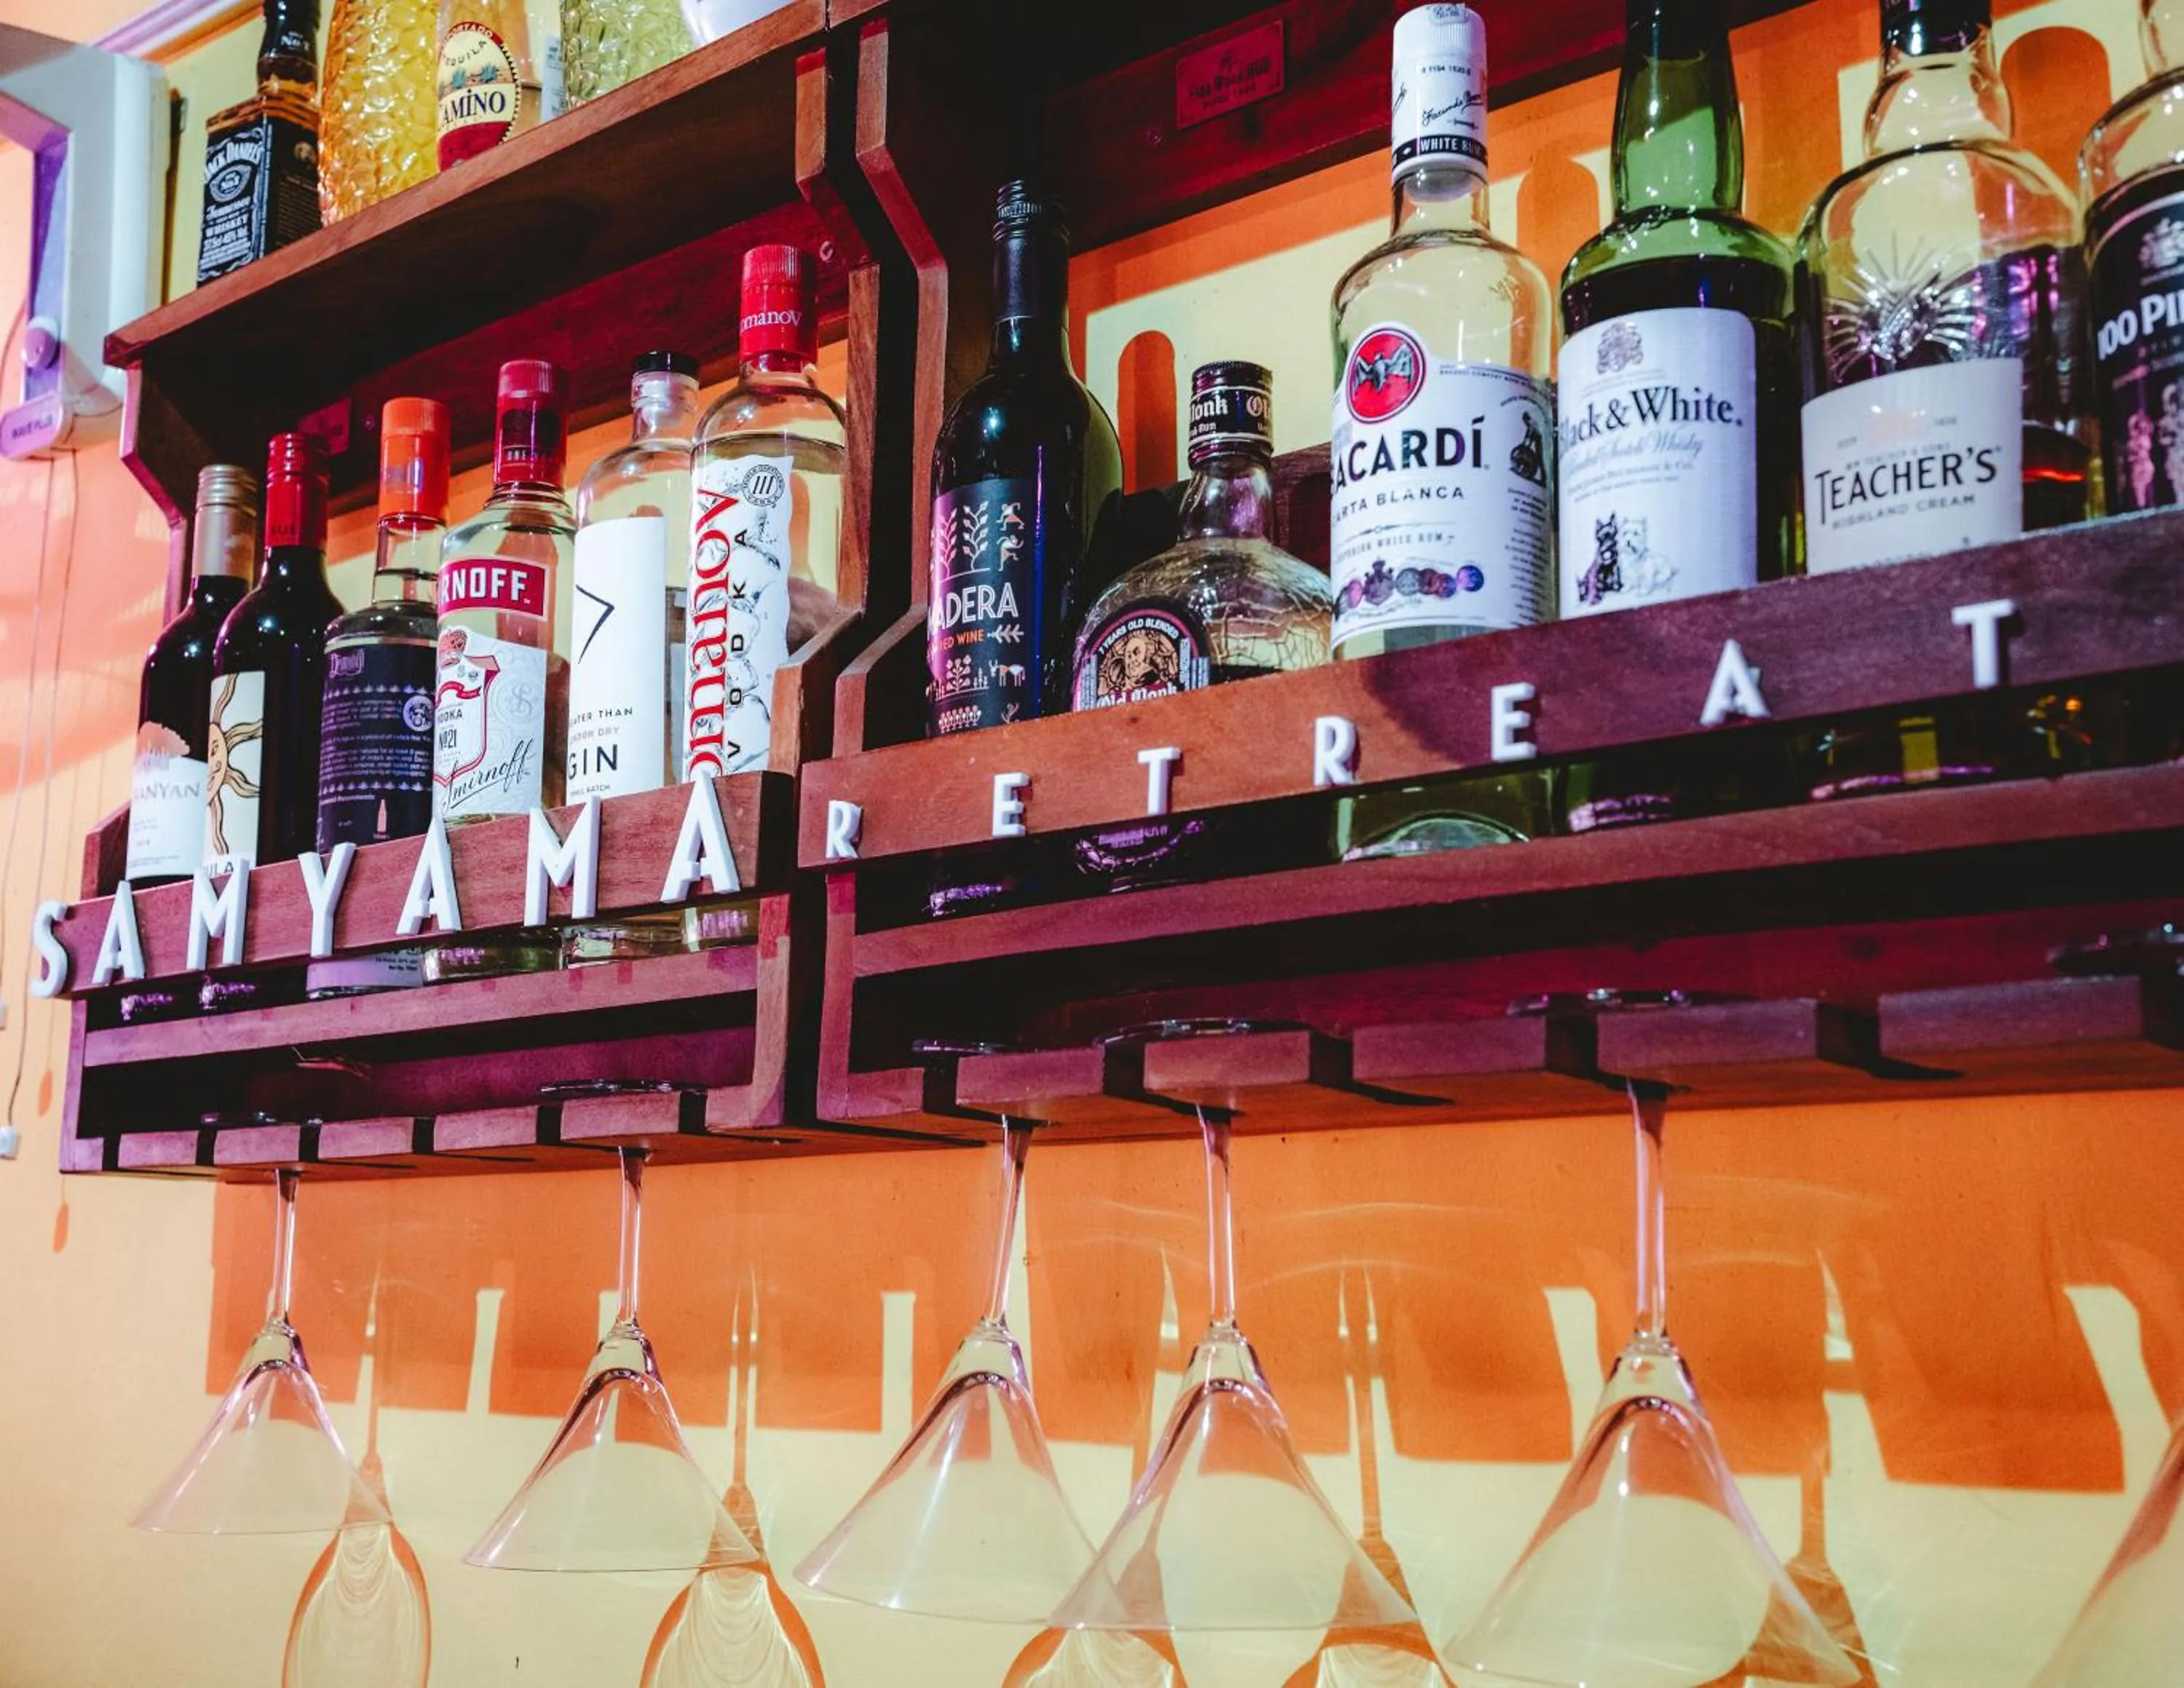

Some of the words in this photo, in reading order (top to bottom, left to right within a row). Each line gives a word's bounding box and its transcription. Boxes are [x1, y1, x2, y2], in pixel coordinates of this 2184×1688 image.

[1420, 137, 1457, 152] WHITE
[2097, 309, 2138, 360] 100
[1332, 415, 1485, 497] ACARDÍ
[1376, 486, 1465, 506] BLANCA
[1814, 446, 1998, 525] TEACHER'S
[955, 628, 986, 645] WINE
[1127, 618, 1144, 631] OLD
[598, 707, 633, 719] THAN
[568, 744, 618, 781] GIN
[31, 770, 740, 998] SAMYAMA
[825, 599, 2019, 860] RETREAT
